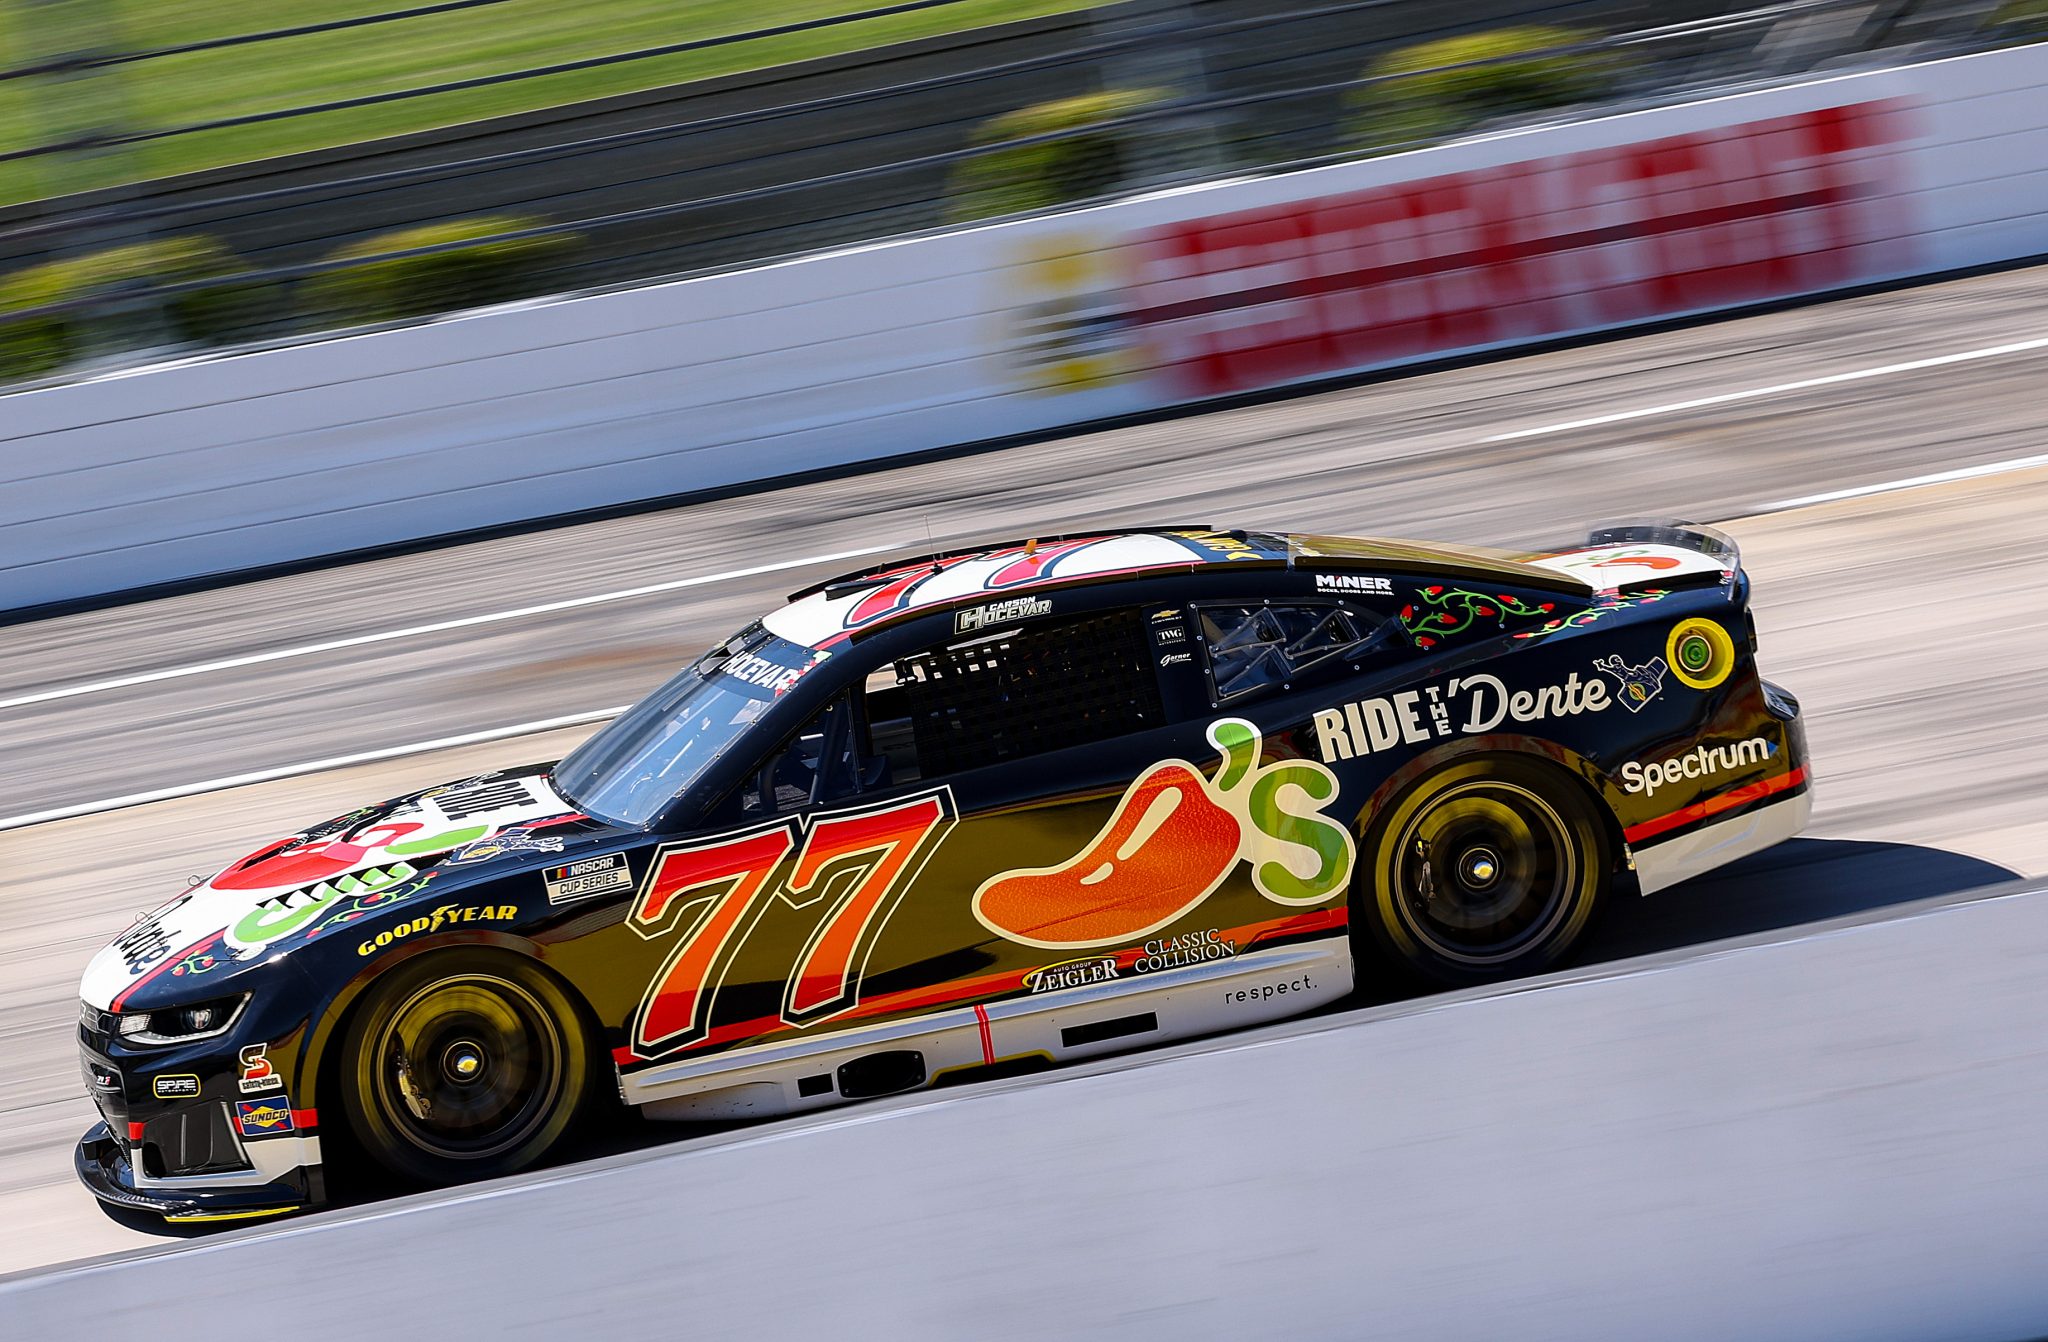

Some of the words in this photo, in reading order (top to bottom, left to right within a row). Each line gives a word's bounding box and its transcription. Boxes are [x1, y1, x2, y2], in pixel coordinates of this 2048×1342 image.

[1315, 574, 1392, 590] MINER
[956, 600, 1052, 634] HOCEVAR
[989, 596, 1036, 611] CARSON
[719, 650, 800, 690] HOCEVAR
[1312, 690, 1430, 764] RIDE
[1425, 686, 1453, 736] THE
[1621, 737, 1770, 797] Spectrum
[570, 857, 614, 876] NASCAR
[560, 880, 581, 895] CUP
[582, 872, 619, 890] SERIES
[624, 785, 960, 1060] 77
[1134, 940, 1236, 974] COLLISION
[1144, 928, 1220, 956] CLASSIC
[1030, 958, 1120, 994] ZEIGLER
[1053, 966, 1070, 974] AUTO
[1071, 961, 1092, 970] GROUP
[1225, 974, 1318, 1005] respect.
[243, 1110, 288, 1124] SUNOCO
